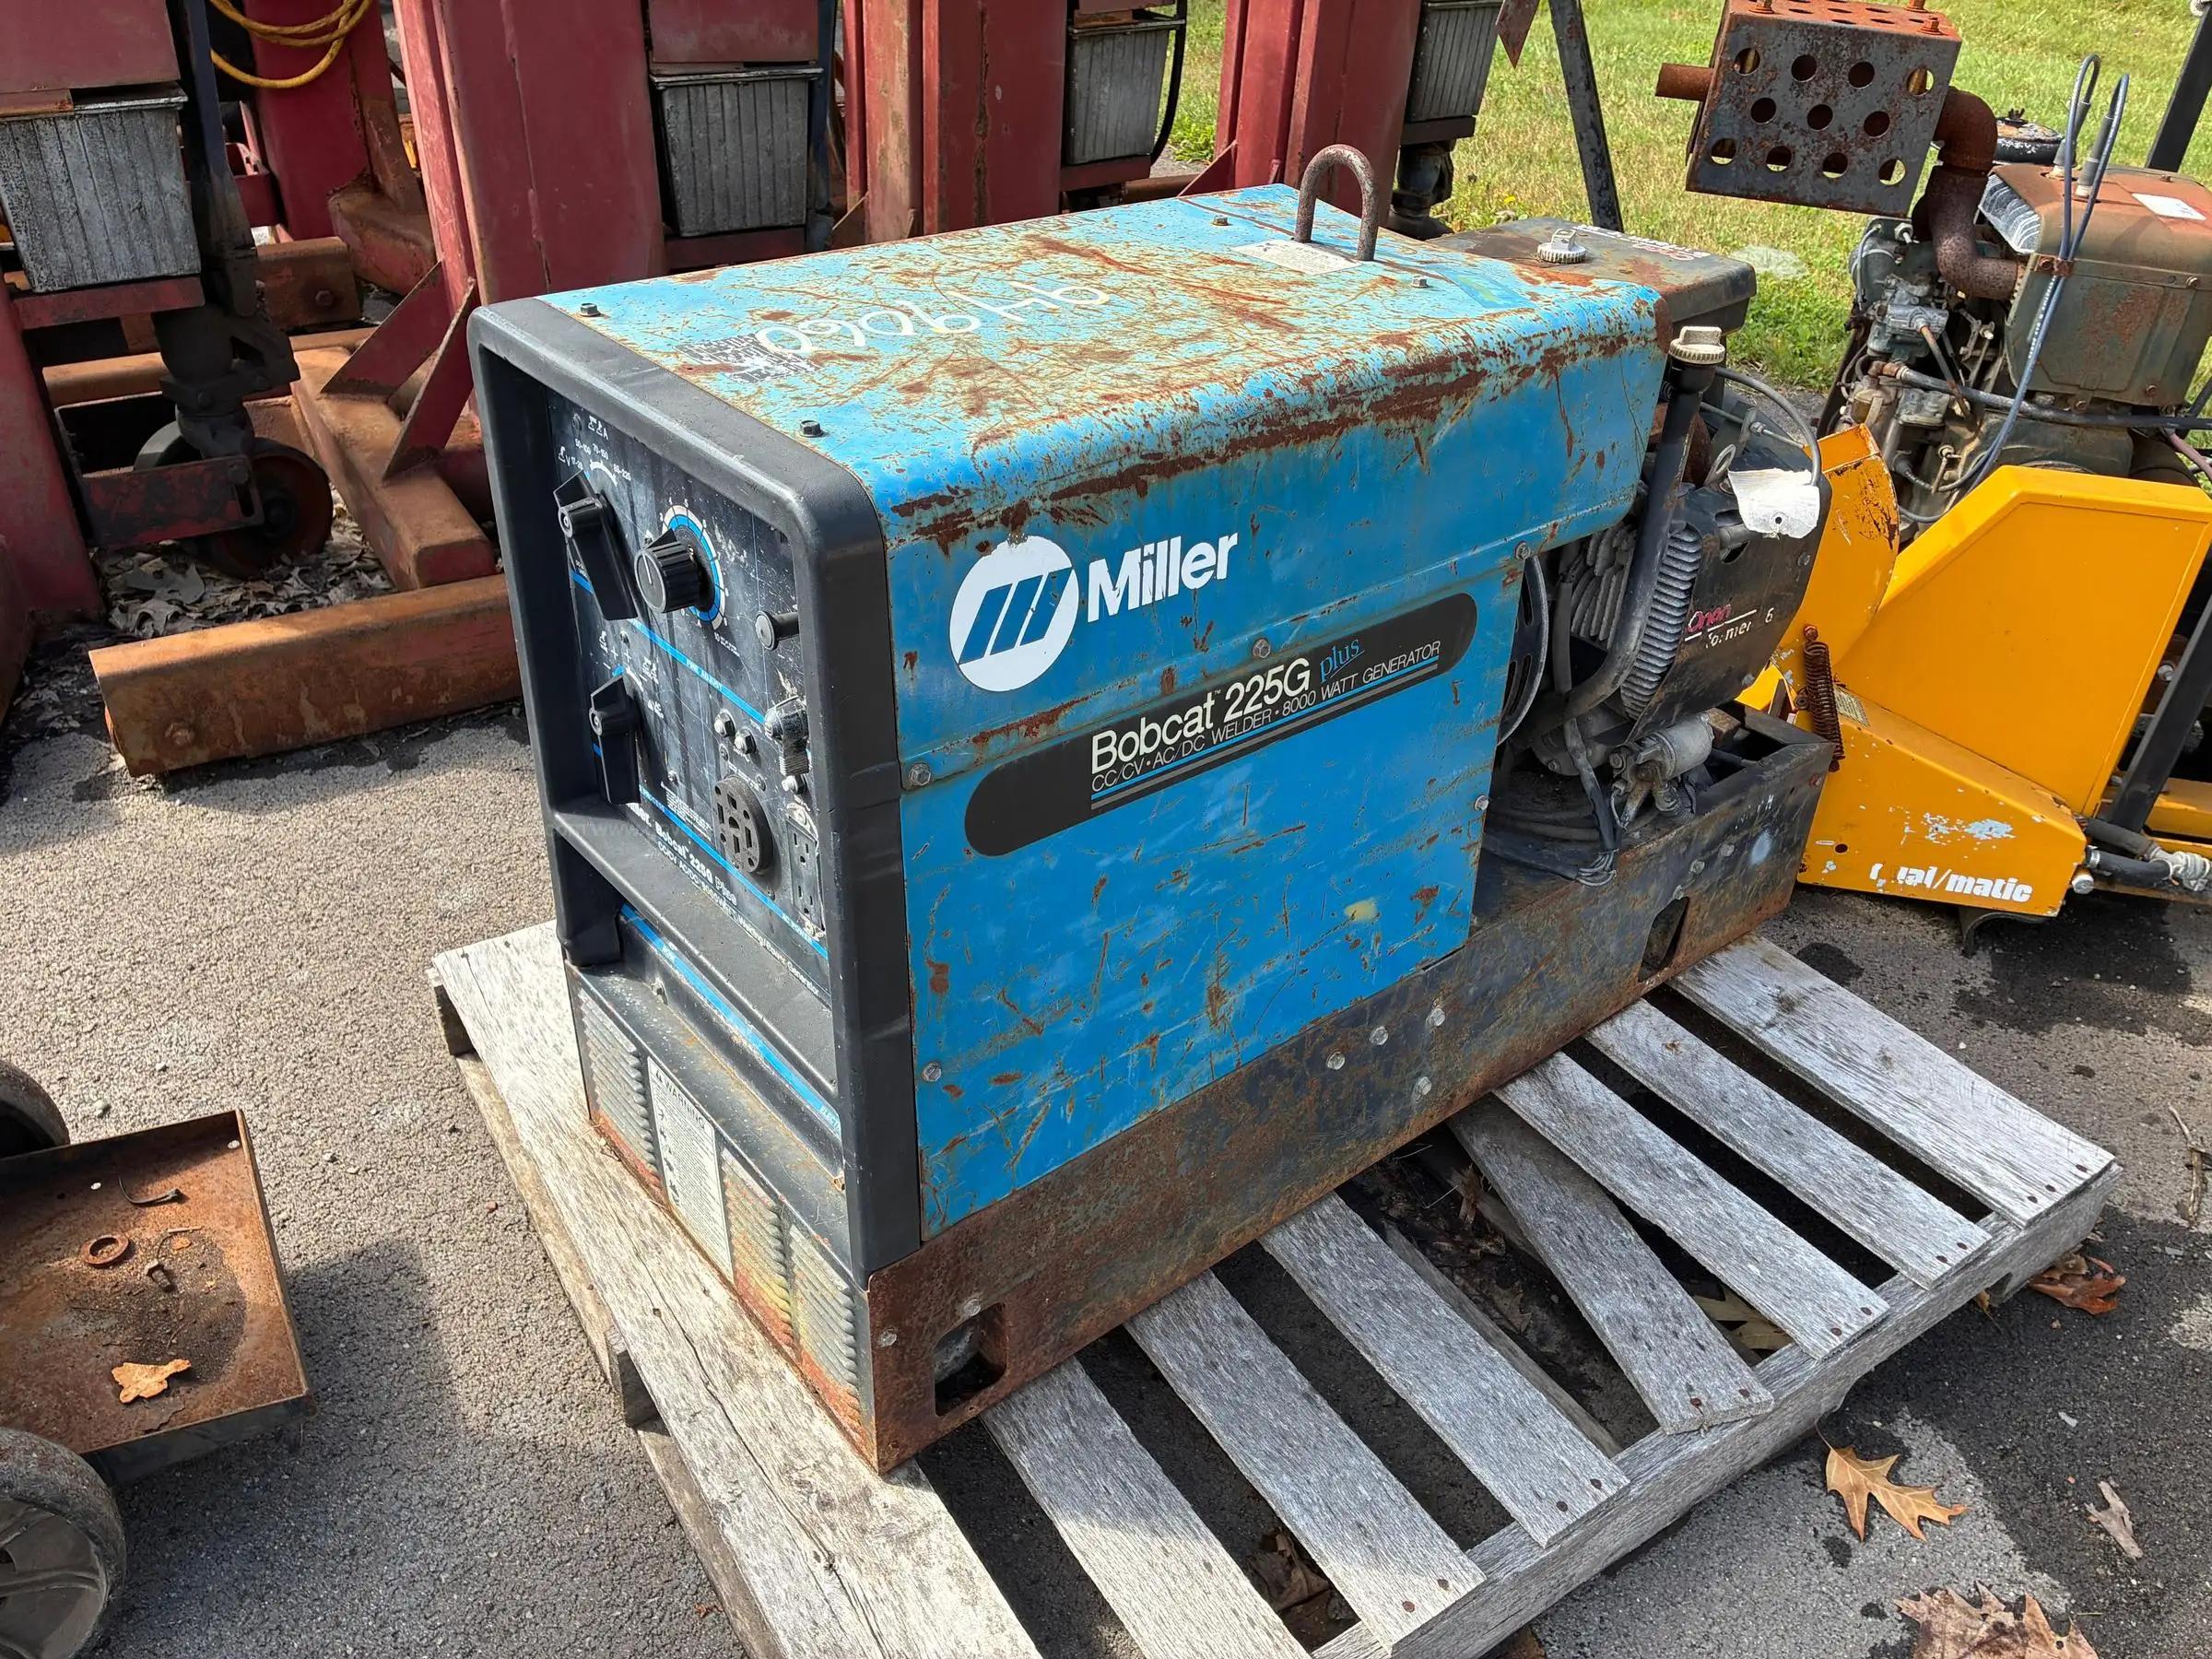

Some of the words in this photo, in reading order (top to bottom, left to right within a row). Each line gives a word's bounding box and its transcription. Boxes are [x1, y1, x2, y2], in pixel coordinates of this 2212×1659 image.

[1087, 533, 1240, 623] Miller
[1688, 604, 1732, 632] Onan
[1091, 691, 1216, 775] Bobcat
[1223, 657, 1312, 724] 225G
[1320, 639, 1359, 684] plus
[1091, 758, 1145, 793] CC/CV
[1152, 735, 1206, 770] AC/DC
[1211, 707, 1273, 745] WELDER
[1282, 690, 1317, 717] 8000
[1321, 673, 1359, 701] WATT
[1362, 641, 1441, 684] GENERATOR
[665, 1078, 708, 1131] WARNING
